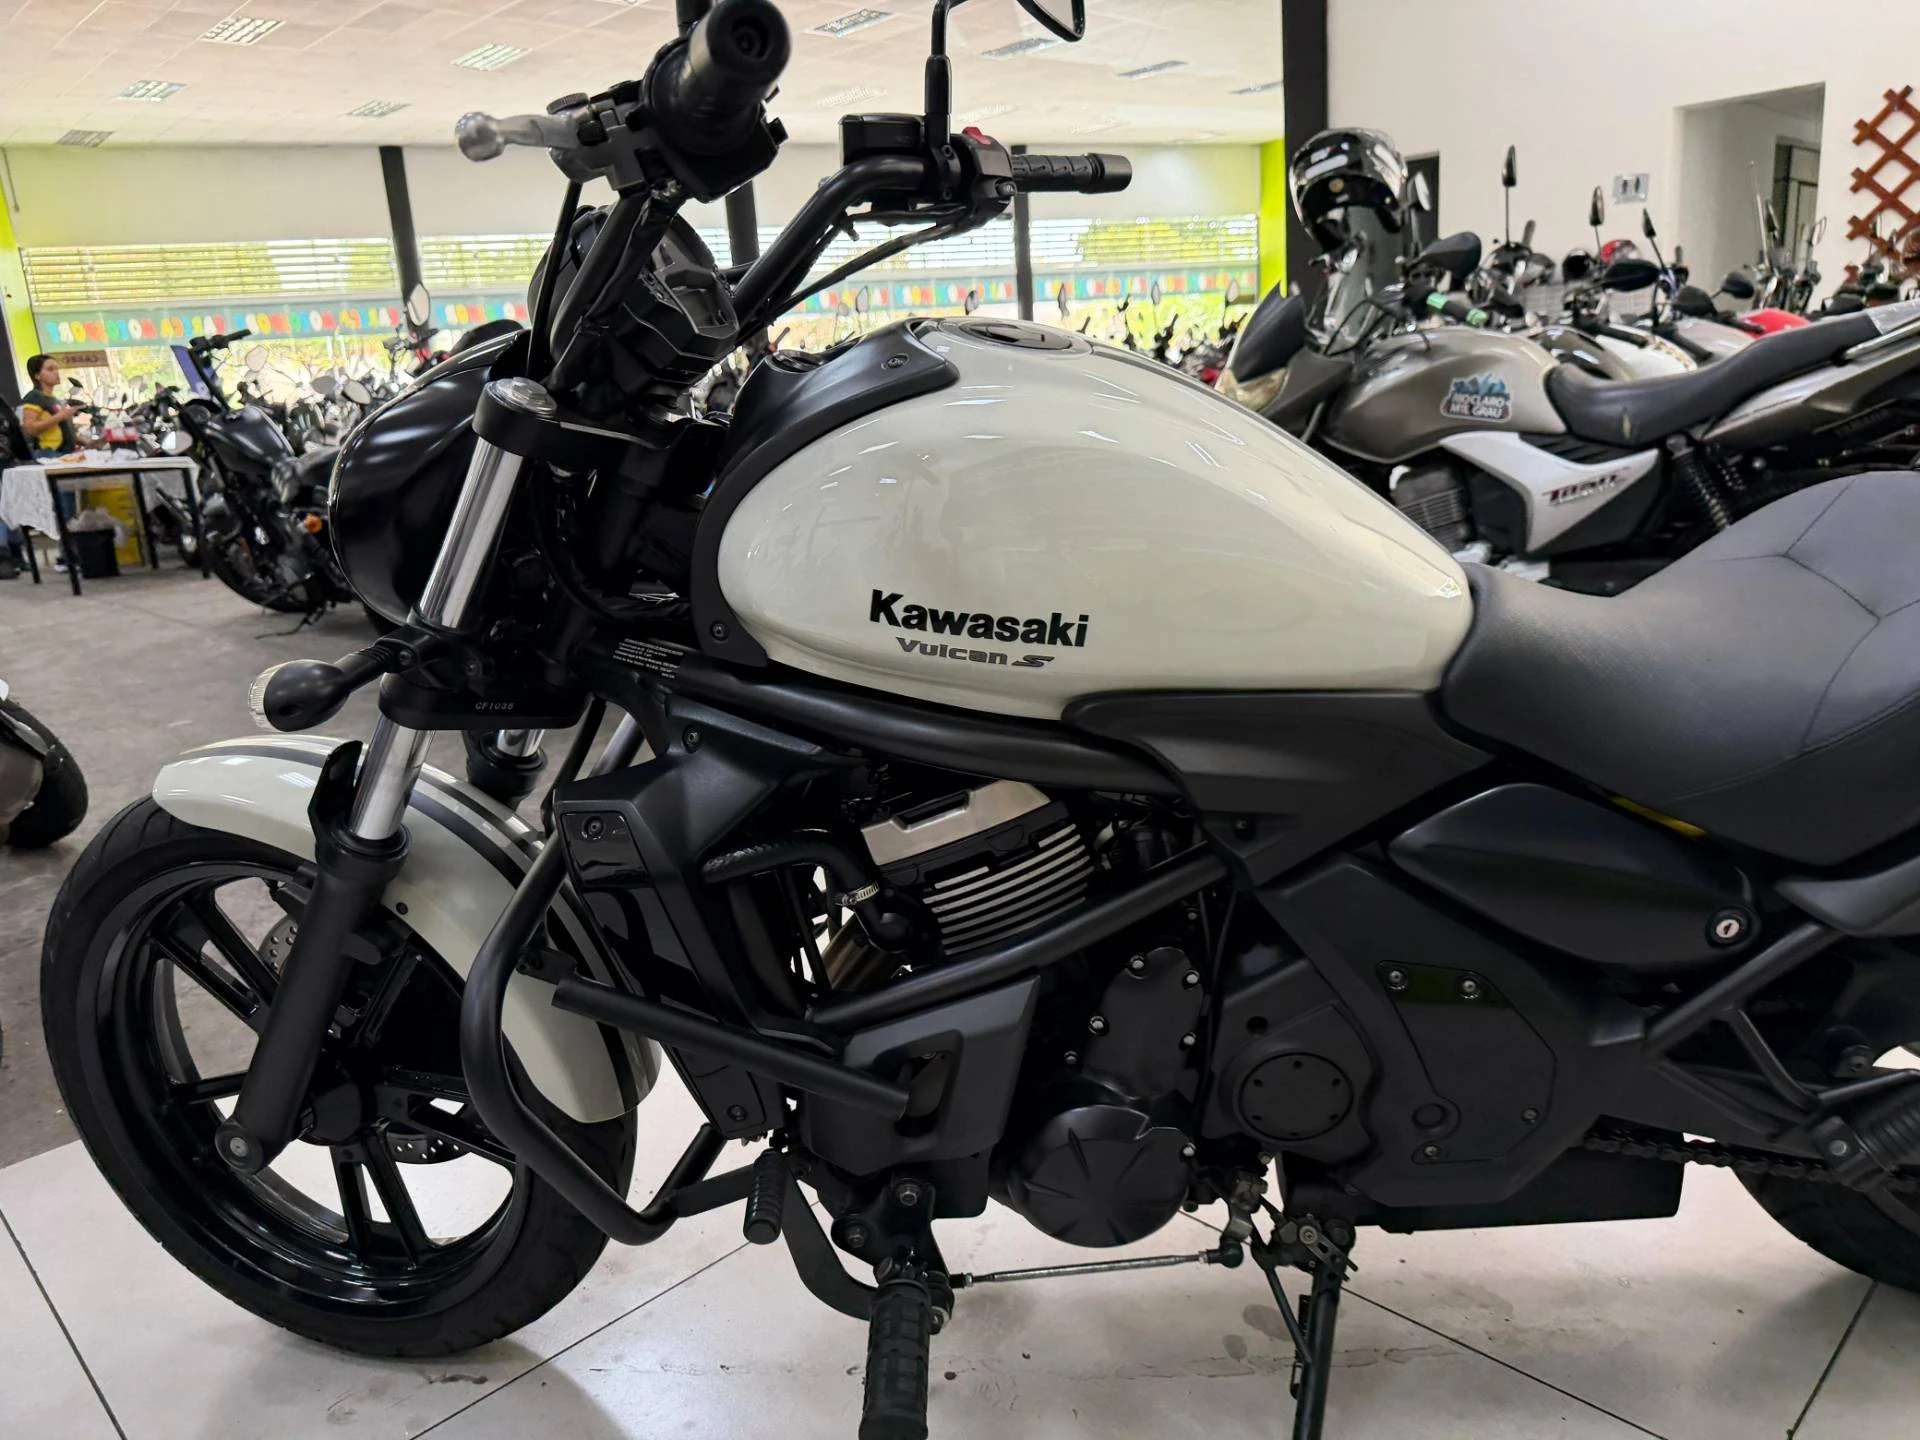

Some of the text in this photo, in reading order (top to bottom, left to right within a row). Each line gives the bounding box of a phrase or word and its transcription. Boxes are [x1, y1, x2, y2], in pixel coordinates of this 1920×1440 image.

[1471, 406, 1502, 418] GRAU
[869, 589, 1090, 647] Kawasaki
[896, 636, 1055, 668] Vulcan S
